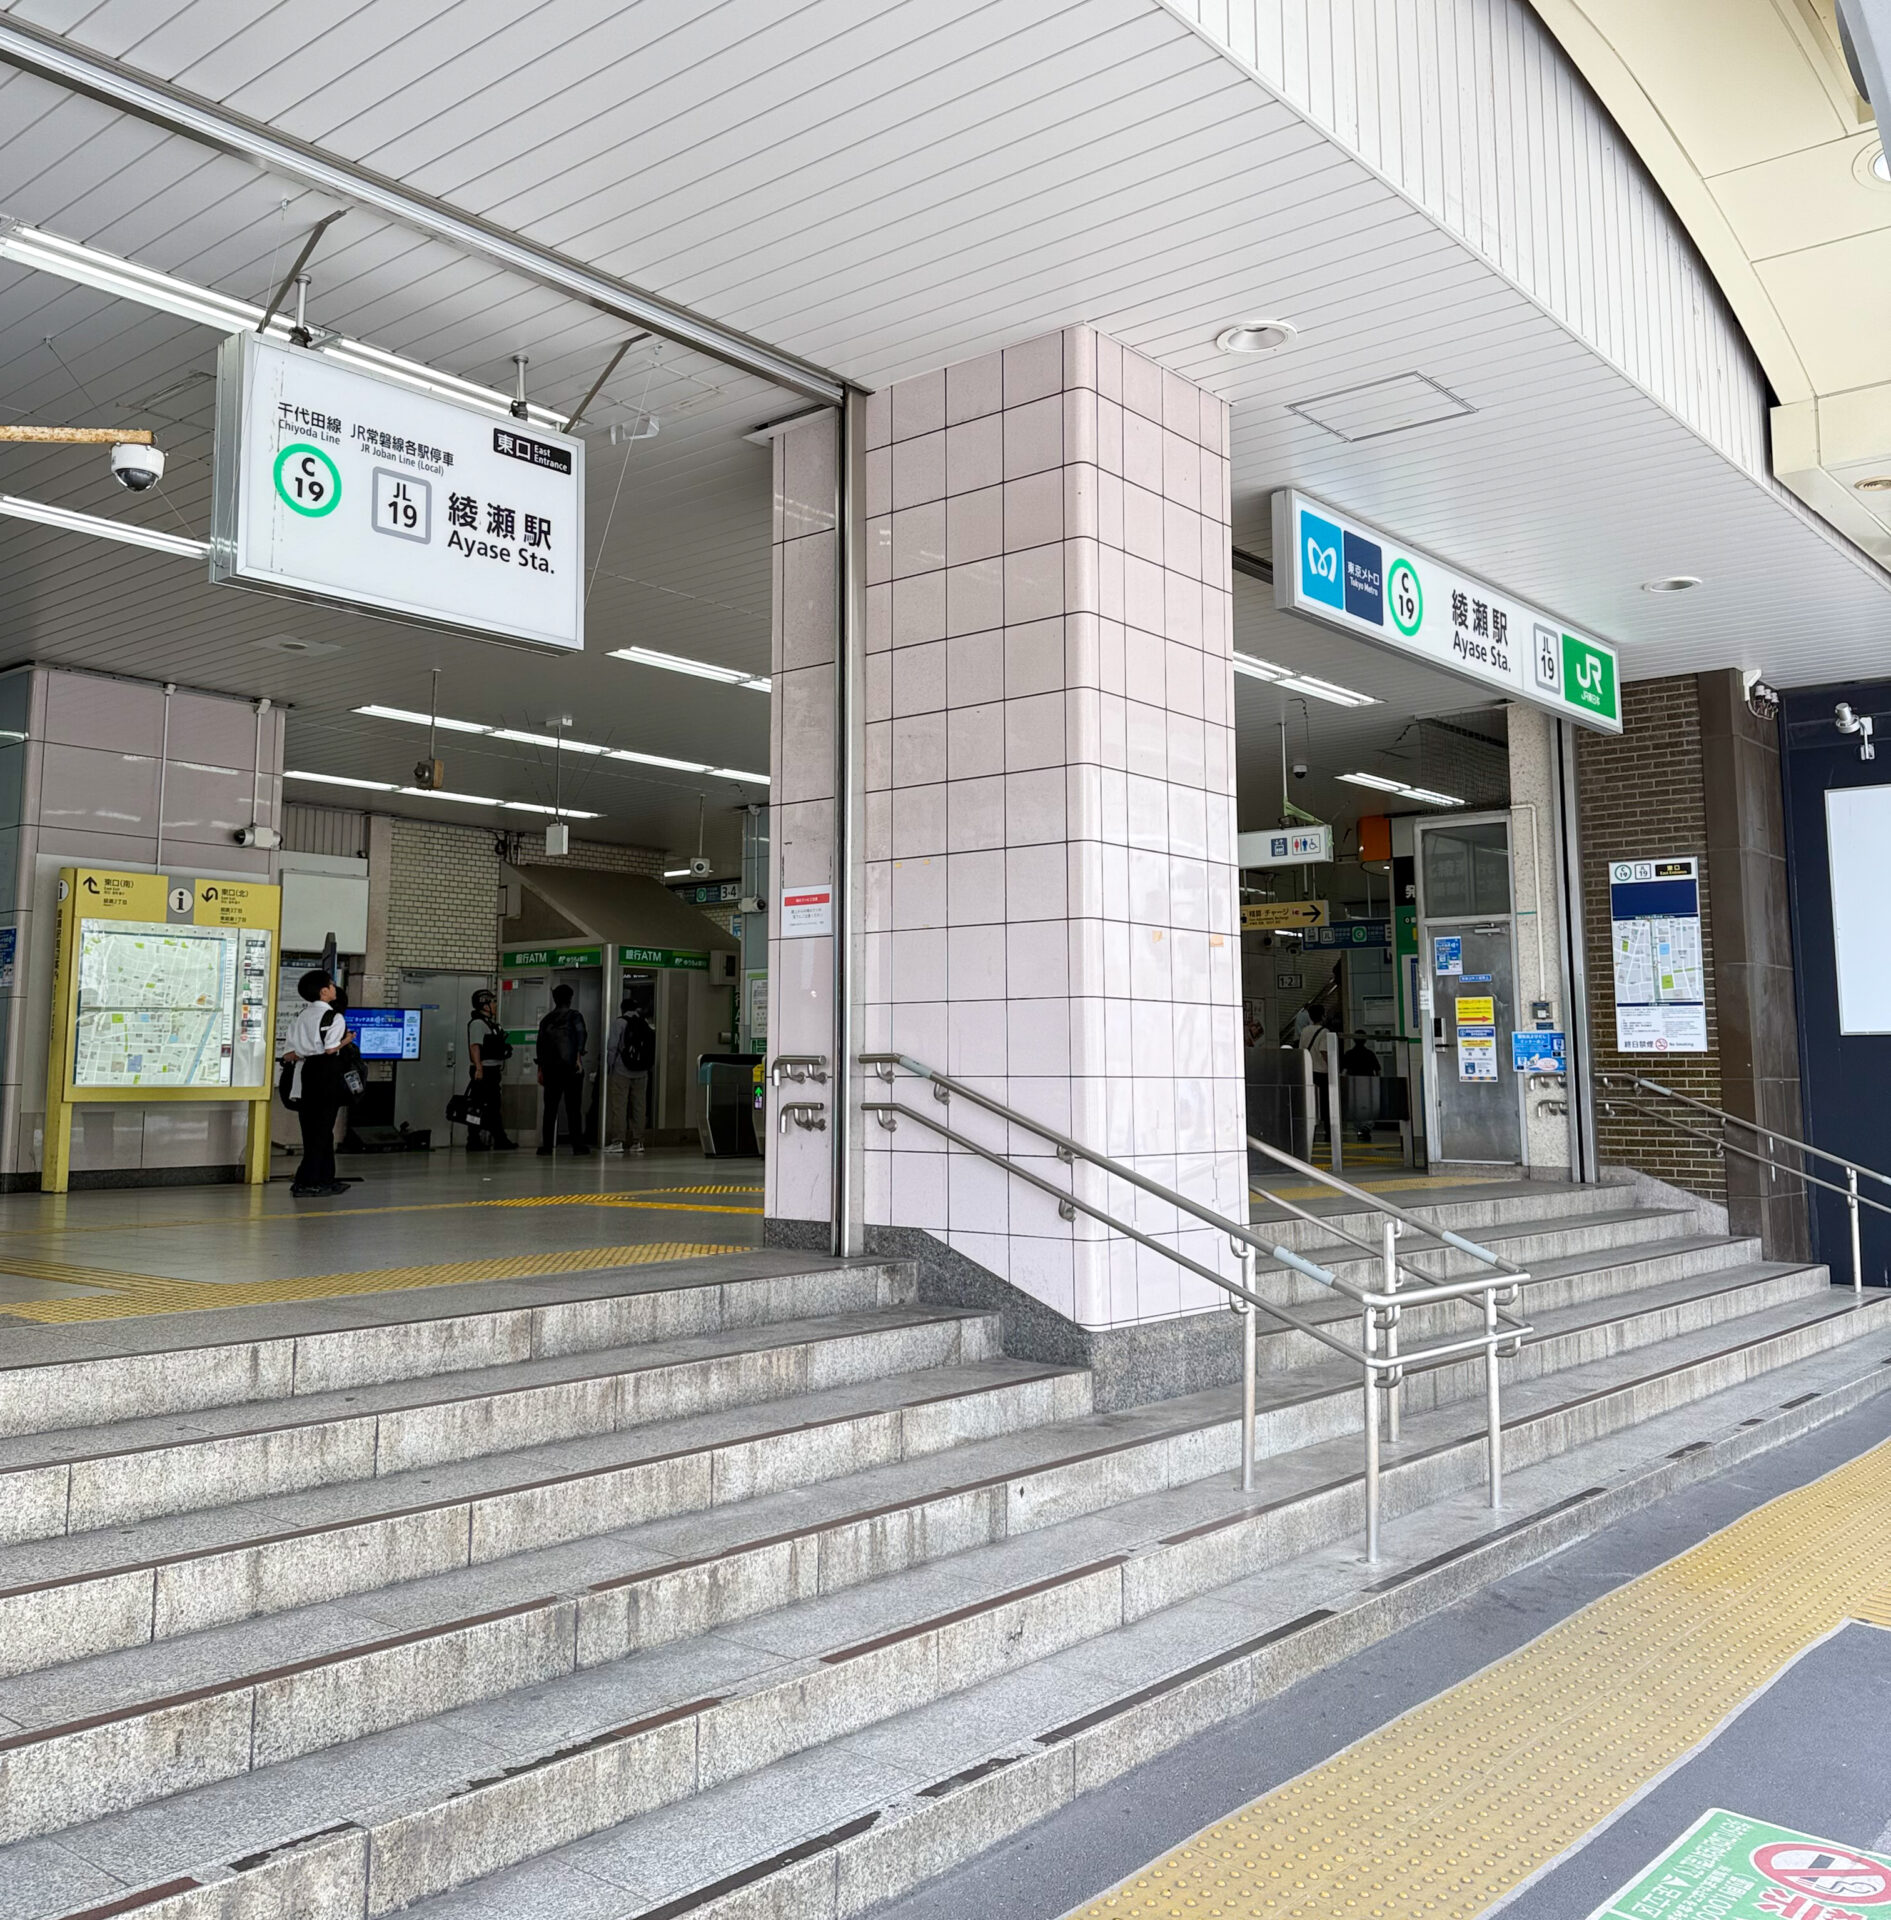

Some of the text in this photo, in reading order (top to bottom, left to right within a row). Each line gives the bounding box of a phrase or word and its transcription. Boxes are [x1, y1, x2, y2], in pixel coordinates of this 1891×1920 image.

[277, 402, 342, 434] 千代田線
[279, 419, 341, 445] Chiyoda Line
[350, 423, 455, 467] JR常磐線各駅停車
[497, 433, 531, 460] 東口
[534, 444, 551, 457] East
[301, 457, 315, 477] C
[361, 443, 444, 477] JR Joban Line (Local)
[534, 454, 568, 472] Entrance
[294, 476, 324, 502] 19
[393, 482, 412, 502] JL
[388, 500, 417, 529] 19
[448, 491, 552, 551] 綾瀬駅
[447, 529, 555, 574] Ayase Sta.
[1347, 561, 1380, 586] 東京メトロ
[1349, 576, 1379, 597] Tokyo Metro
[1401, 572, 1409, 593] C
[1398, 594, 1414, 620] 19
[1452, 588, 1508, 646] 綾瀬駅
[1453, 630, 1511, 673] Ayase Sta.
[1542, 636, 1551, 654] JL
[1541, 654, 1554, 680] 19
[1576, 653, 1603, 695] JR
[515, 952, 547, 964] 銀行ATM
[625, 949, 662, 962] 銀行ATM
[1631, 1882, 1683, 1918] 足立区
